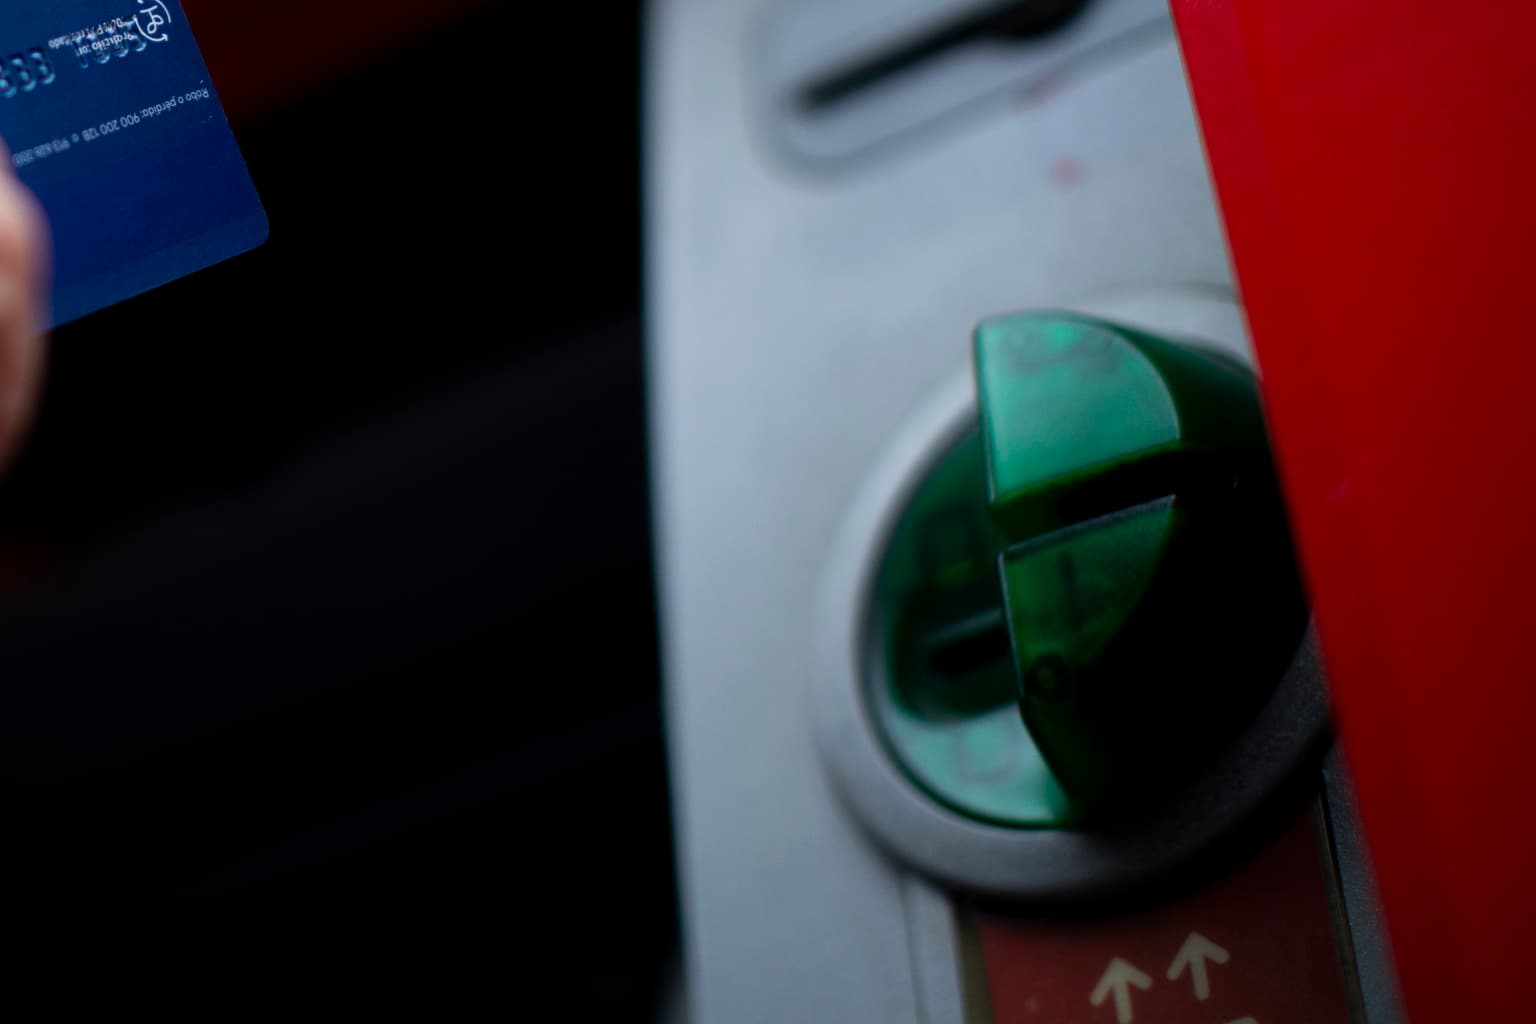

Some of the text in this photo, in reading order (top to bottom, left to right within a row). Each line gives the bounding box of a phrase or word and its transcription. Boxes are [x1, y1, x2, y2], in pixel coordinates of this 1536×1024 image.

[178, 95, 185, 104] o
[185, 87, 210, 102] Robo
[100, 119, 120, 136] 200
[119, 114, 141, 128] 900
[81, 127, 100, 142] 128
